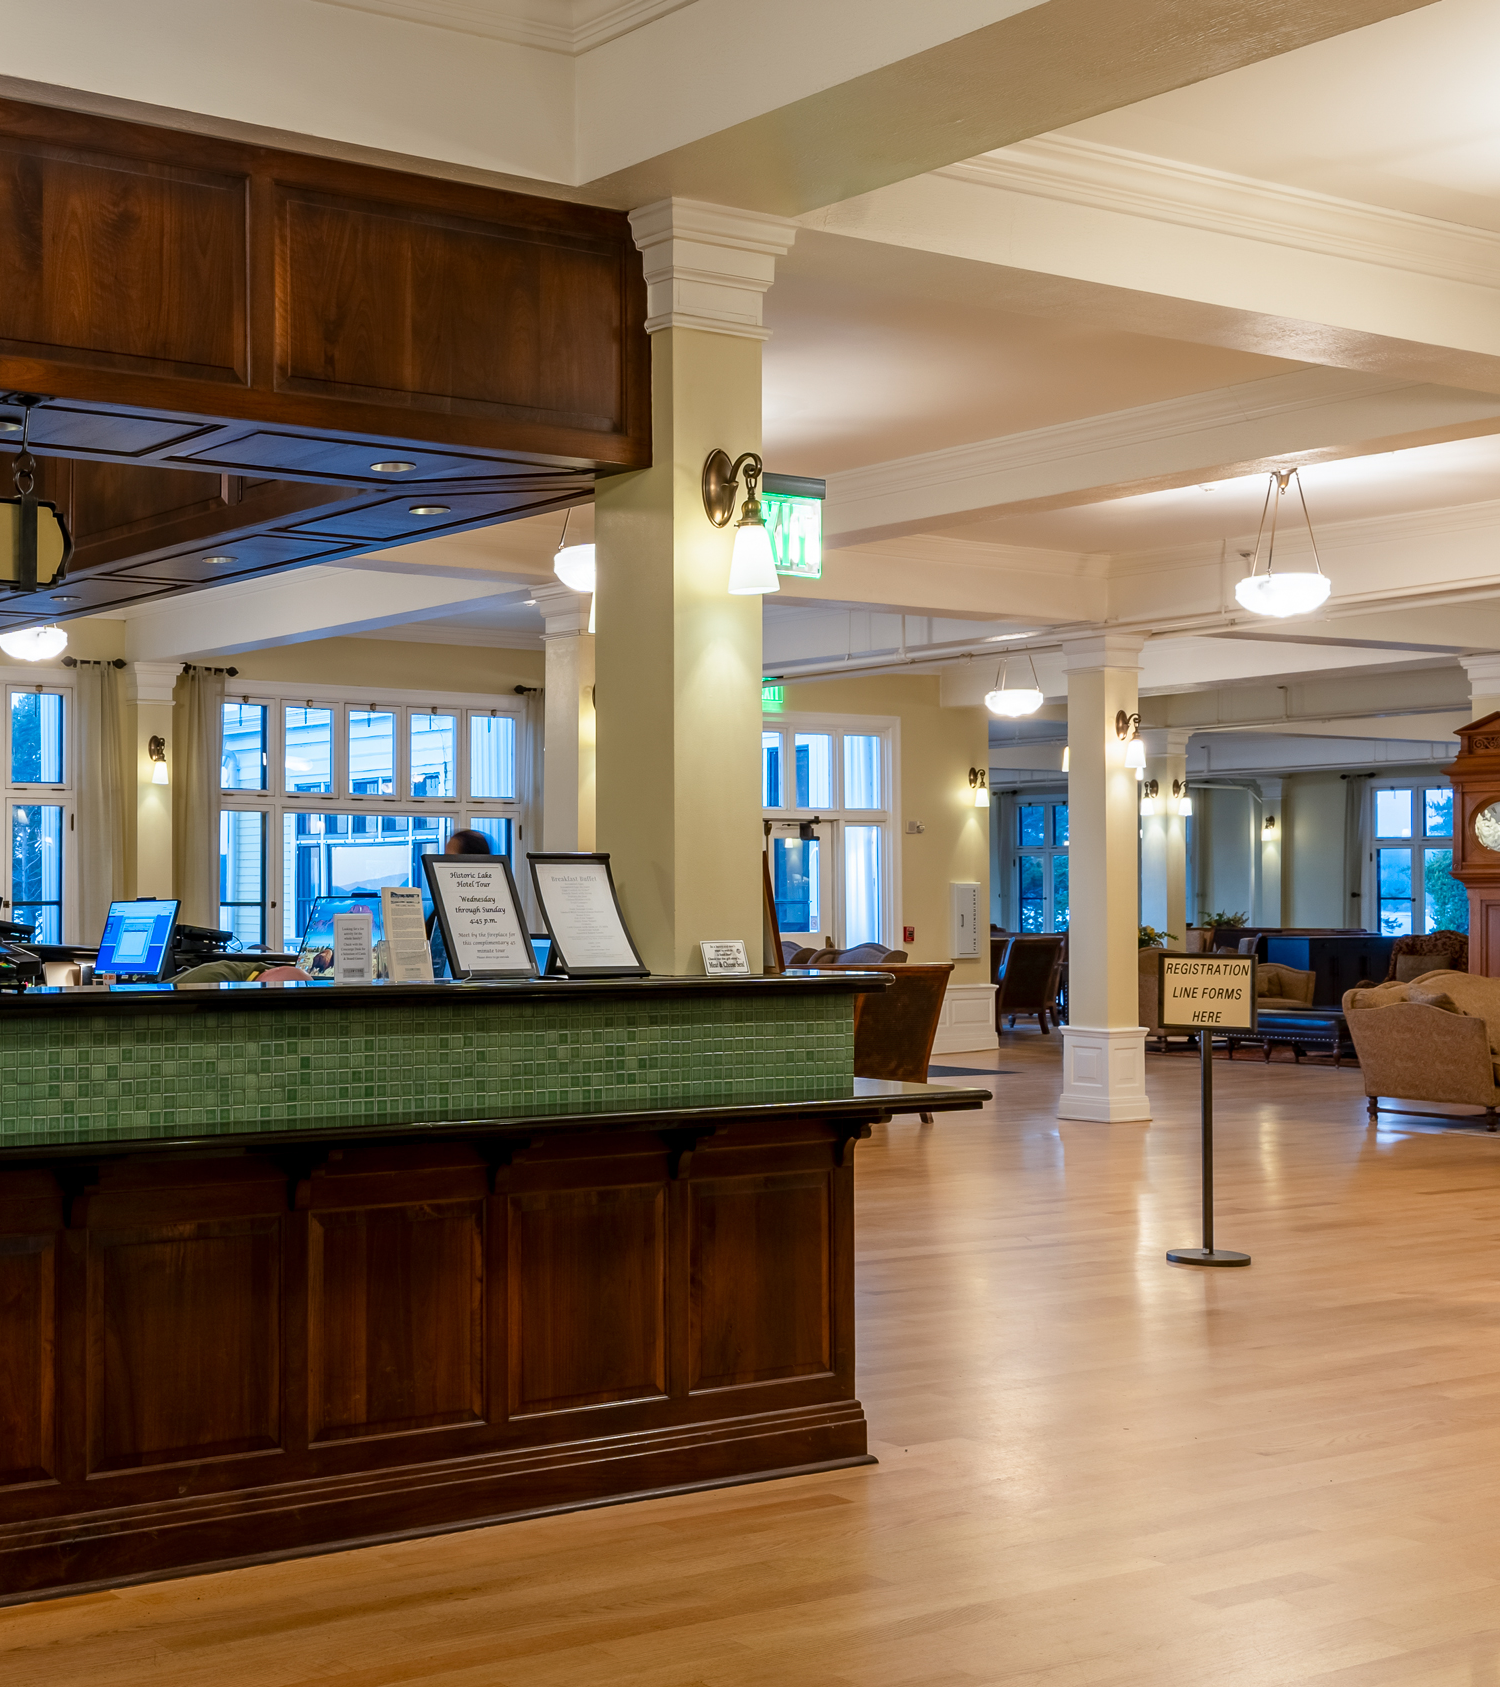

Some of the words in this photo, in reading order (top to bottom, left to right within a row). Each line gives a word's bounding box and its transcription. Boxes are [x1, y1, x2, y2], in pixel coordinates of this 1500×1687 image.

[459, 896, 496, 904] Wednesday
[455, 906, 480, 915] through
[482, 906, 506, 914] Sunday
[1165, 962, 1250, 976] REGISTRATION
[1173, 986, 1198, 999] LINE
[1202, 987, 1242, 1000] FORMS
[1192, 1011, 1222, 1023] HERE
